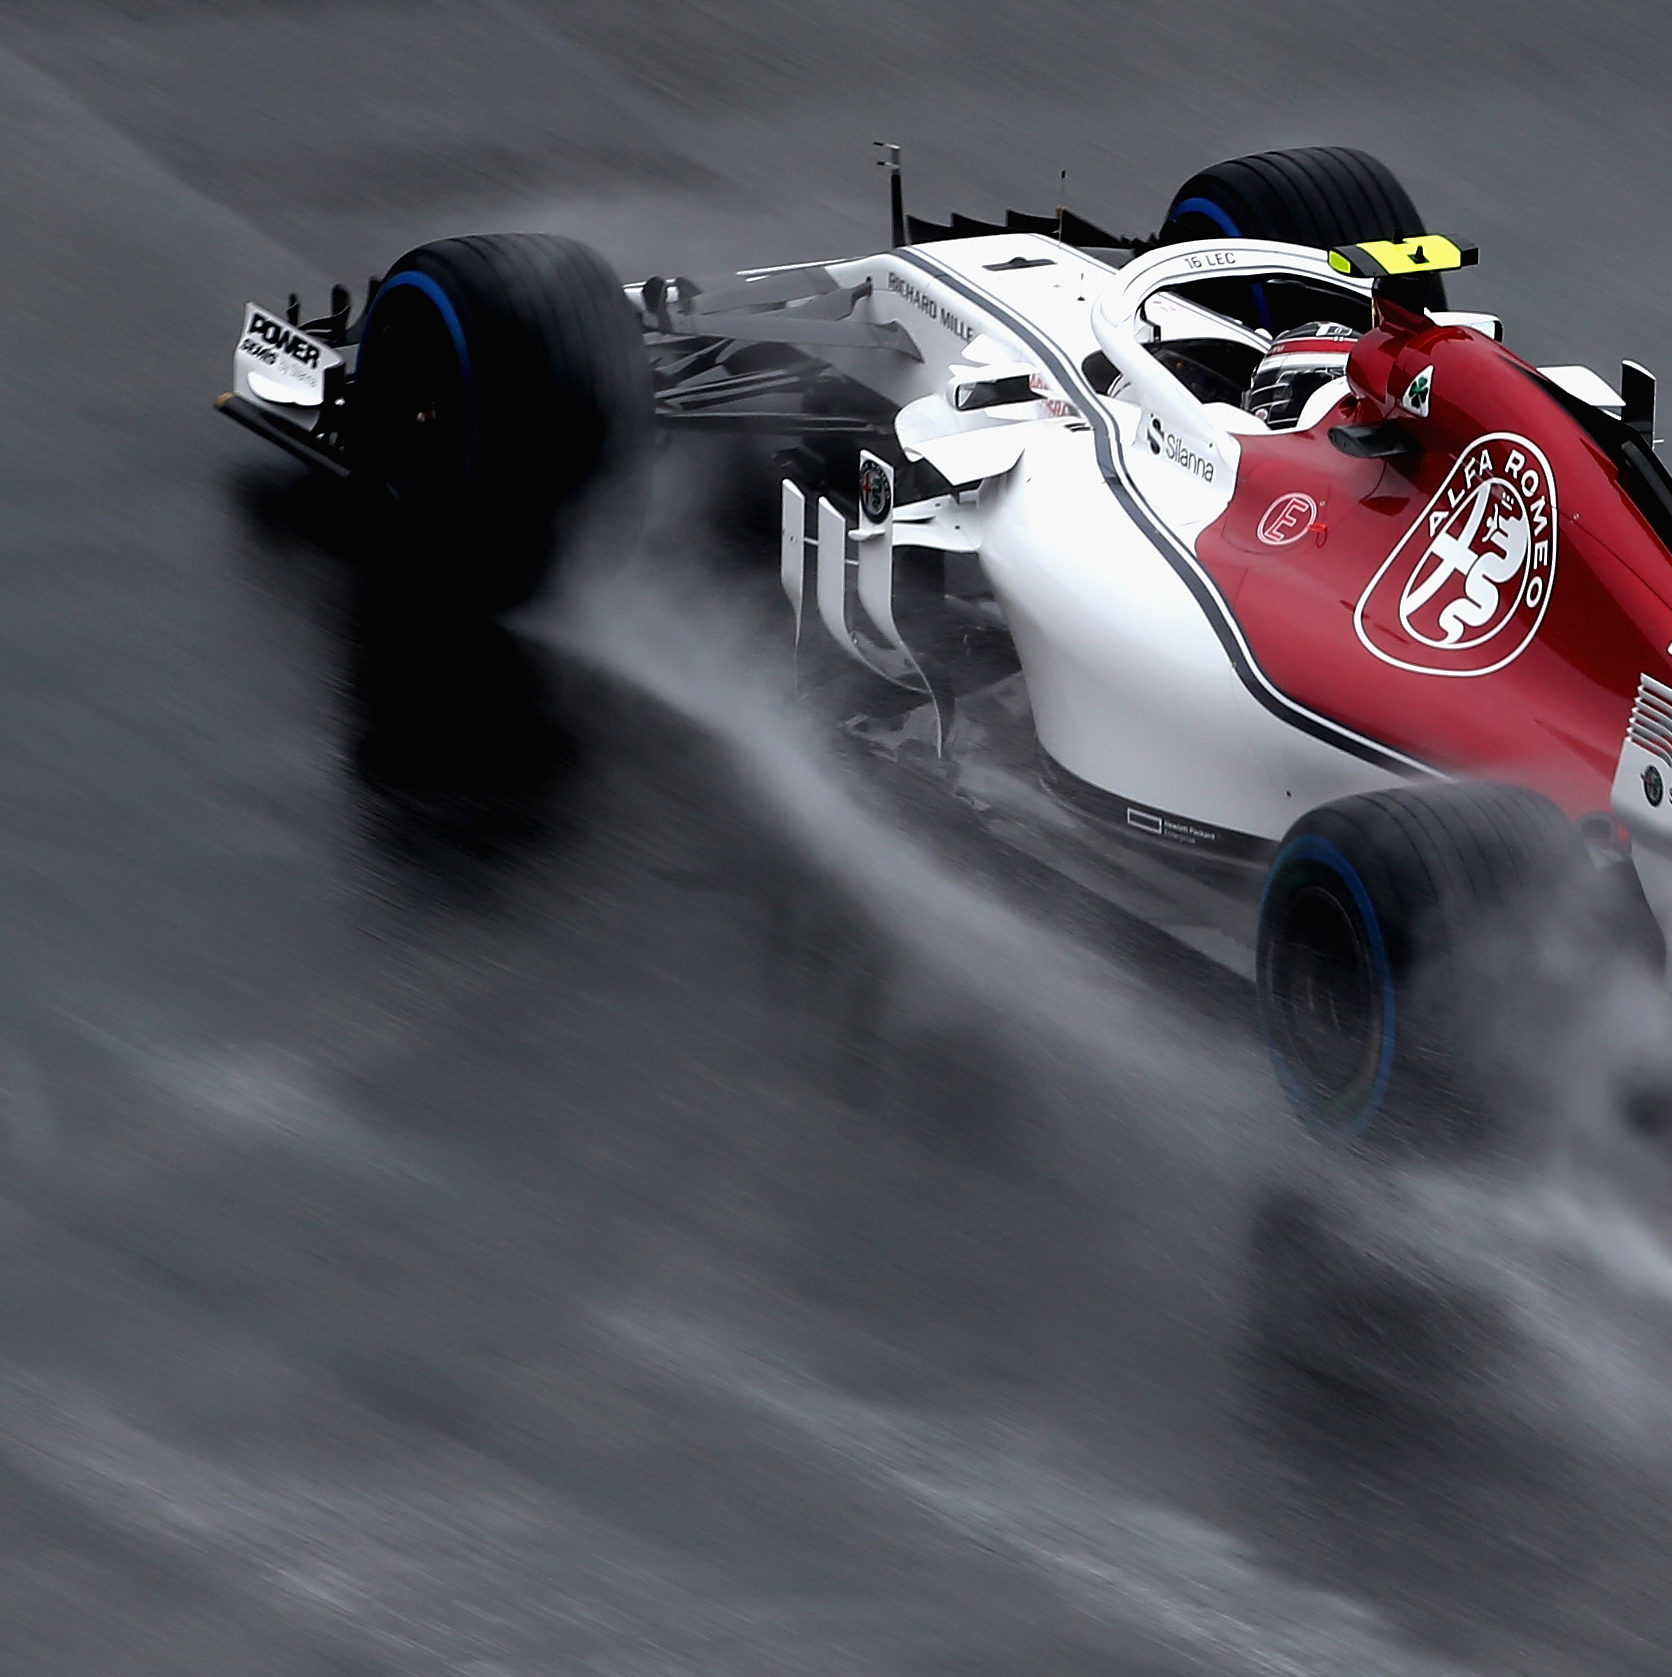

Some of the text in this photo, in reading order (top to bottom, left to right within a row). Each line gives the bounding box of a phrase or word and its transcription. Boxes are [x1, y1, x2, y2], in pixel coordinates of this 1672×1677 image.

[1184, 252, 1237, 270] 16 LEC
[888, 271, 973, 344] RICHARD MILLE
[249, 313, 320, 369] POWER
[1165, 433, 1214, 484] Silanna
[1264, 497, 1309, 541] E
[1428, 449, 1549, 608] ALFA ROMEO
